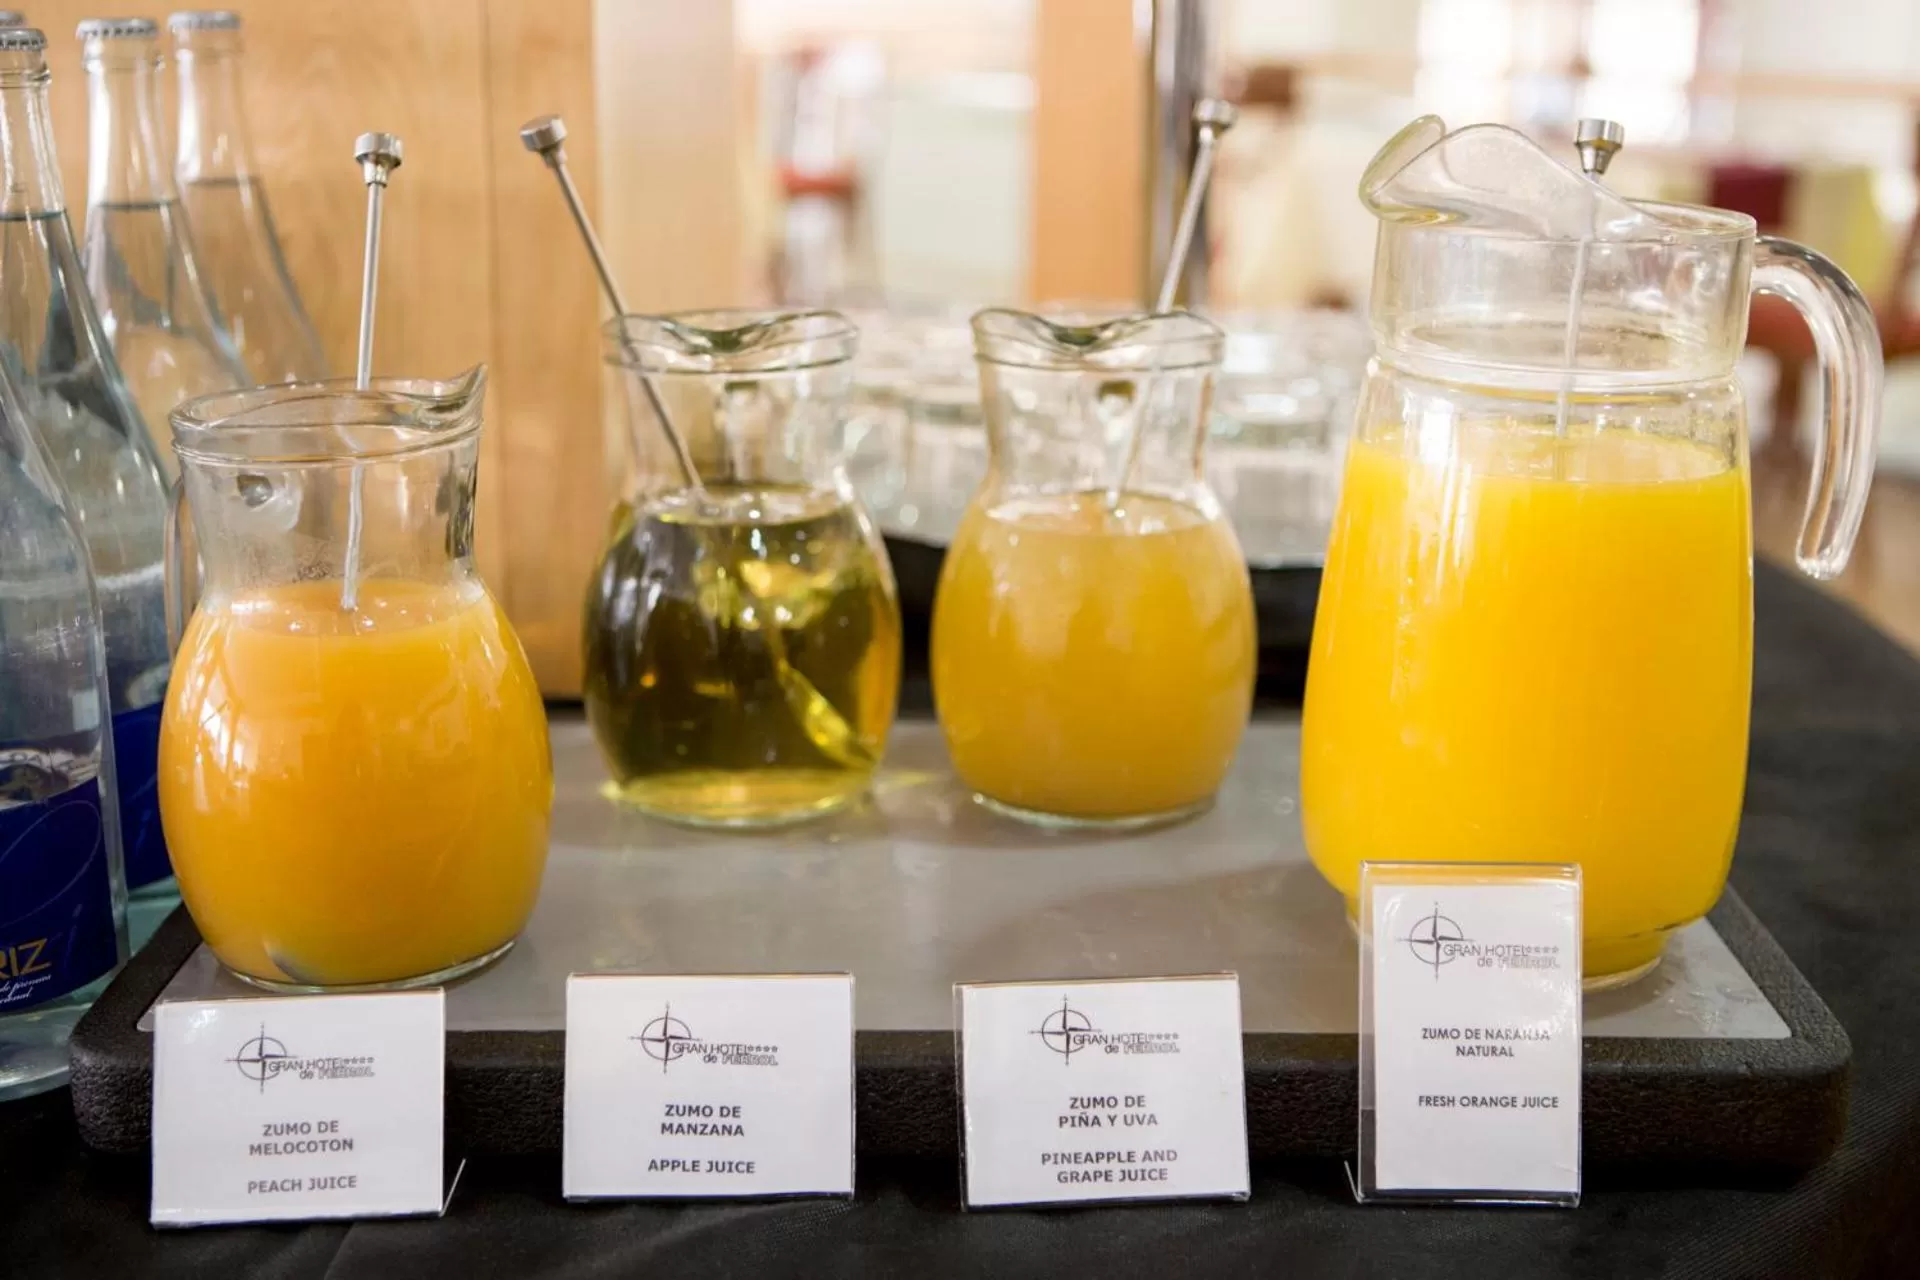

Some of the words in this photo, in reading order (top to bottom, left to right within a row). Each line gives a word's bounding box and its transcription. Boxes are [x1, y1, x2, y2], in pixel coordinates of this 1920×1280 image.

[1443, 944, 1481, 957] GRAN
[1485, 944, 1528, 957] HOTEL
[1477, 956, 1493, 968] de
[1073, 1033, 1108, 1046] GRAN
[1111, 1032, 1149, 1045] HOTEL
[1421, 1028, 1461, 1040] ZUMO
[1464, 1028, 1481, 1040] DE
[1485, 1028, 1550, 1041] NARANJA
[672, 1043, 708, 1054] GRAN
[710, 1043, 750, 1056] HOTEL
[1104, 1044, 1119, 1054] de
[1456, 1045, 1514, 1057] NATURAL
[268, 1060, 303, 1072] GRAN
[306, 1058, 344, 1070] HOTEL
[703, 1053, 718, 1064] de
[299, 1069, 314, 1080] de
[1069, 1096, 1118, 1109] ZUMO
[1124, 1095, 1146, 1108] DE
[1418, 1095, 1455, 1107] FRESH
[1459, 1095, 1518, 1108] ORANGE
[1521, 1096, 1559, 1108] JUICE
[664, 1104, 714, 1118] ZUMO
[719, 1105, 742, 1119] DE
[1058, 1111, 1102, 1128] PIÑA
[1106, 1114, 1118, 1127] Y
[1123, 1113, 1159, 1127] UVA
[262, 1121, 312, 1137] ZUMO
[317, 1120, 339, 1134] DE
[660, 1122, 745, 1137] MANZANA
[248, 1137, 354, 1156] MELOCOTON
[1041, 1151, 1137, 1165] PINEAPPLE
[1141, 1149, 1178, 1162] AND
[647, 1158, 701, 1173] APPLE
[705, 1159, 756, 1174] JUICE
[1056, 1169, 1114, 1183] GRAPE
[1119, 1168, 1168, 1182] JUICE
[247, 1178, 302, 1194] PEACH
[307, 1175, 357, 1191] JUICE
